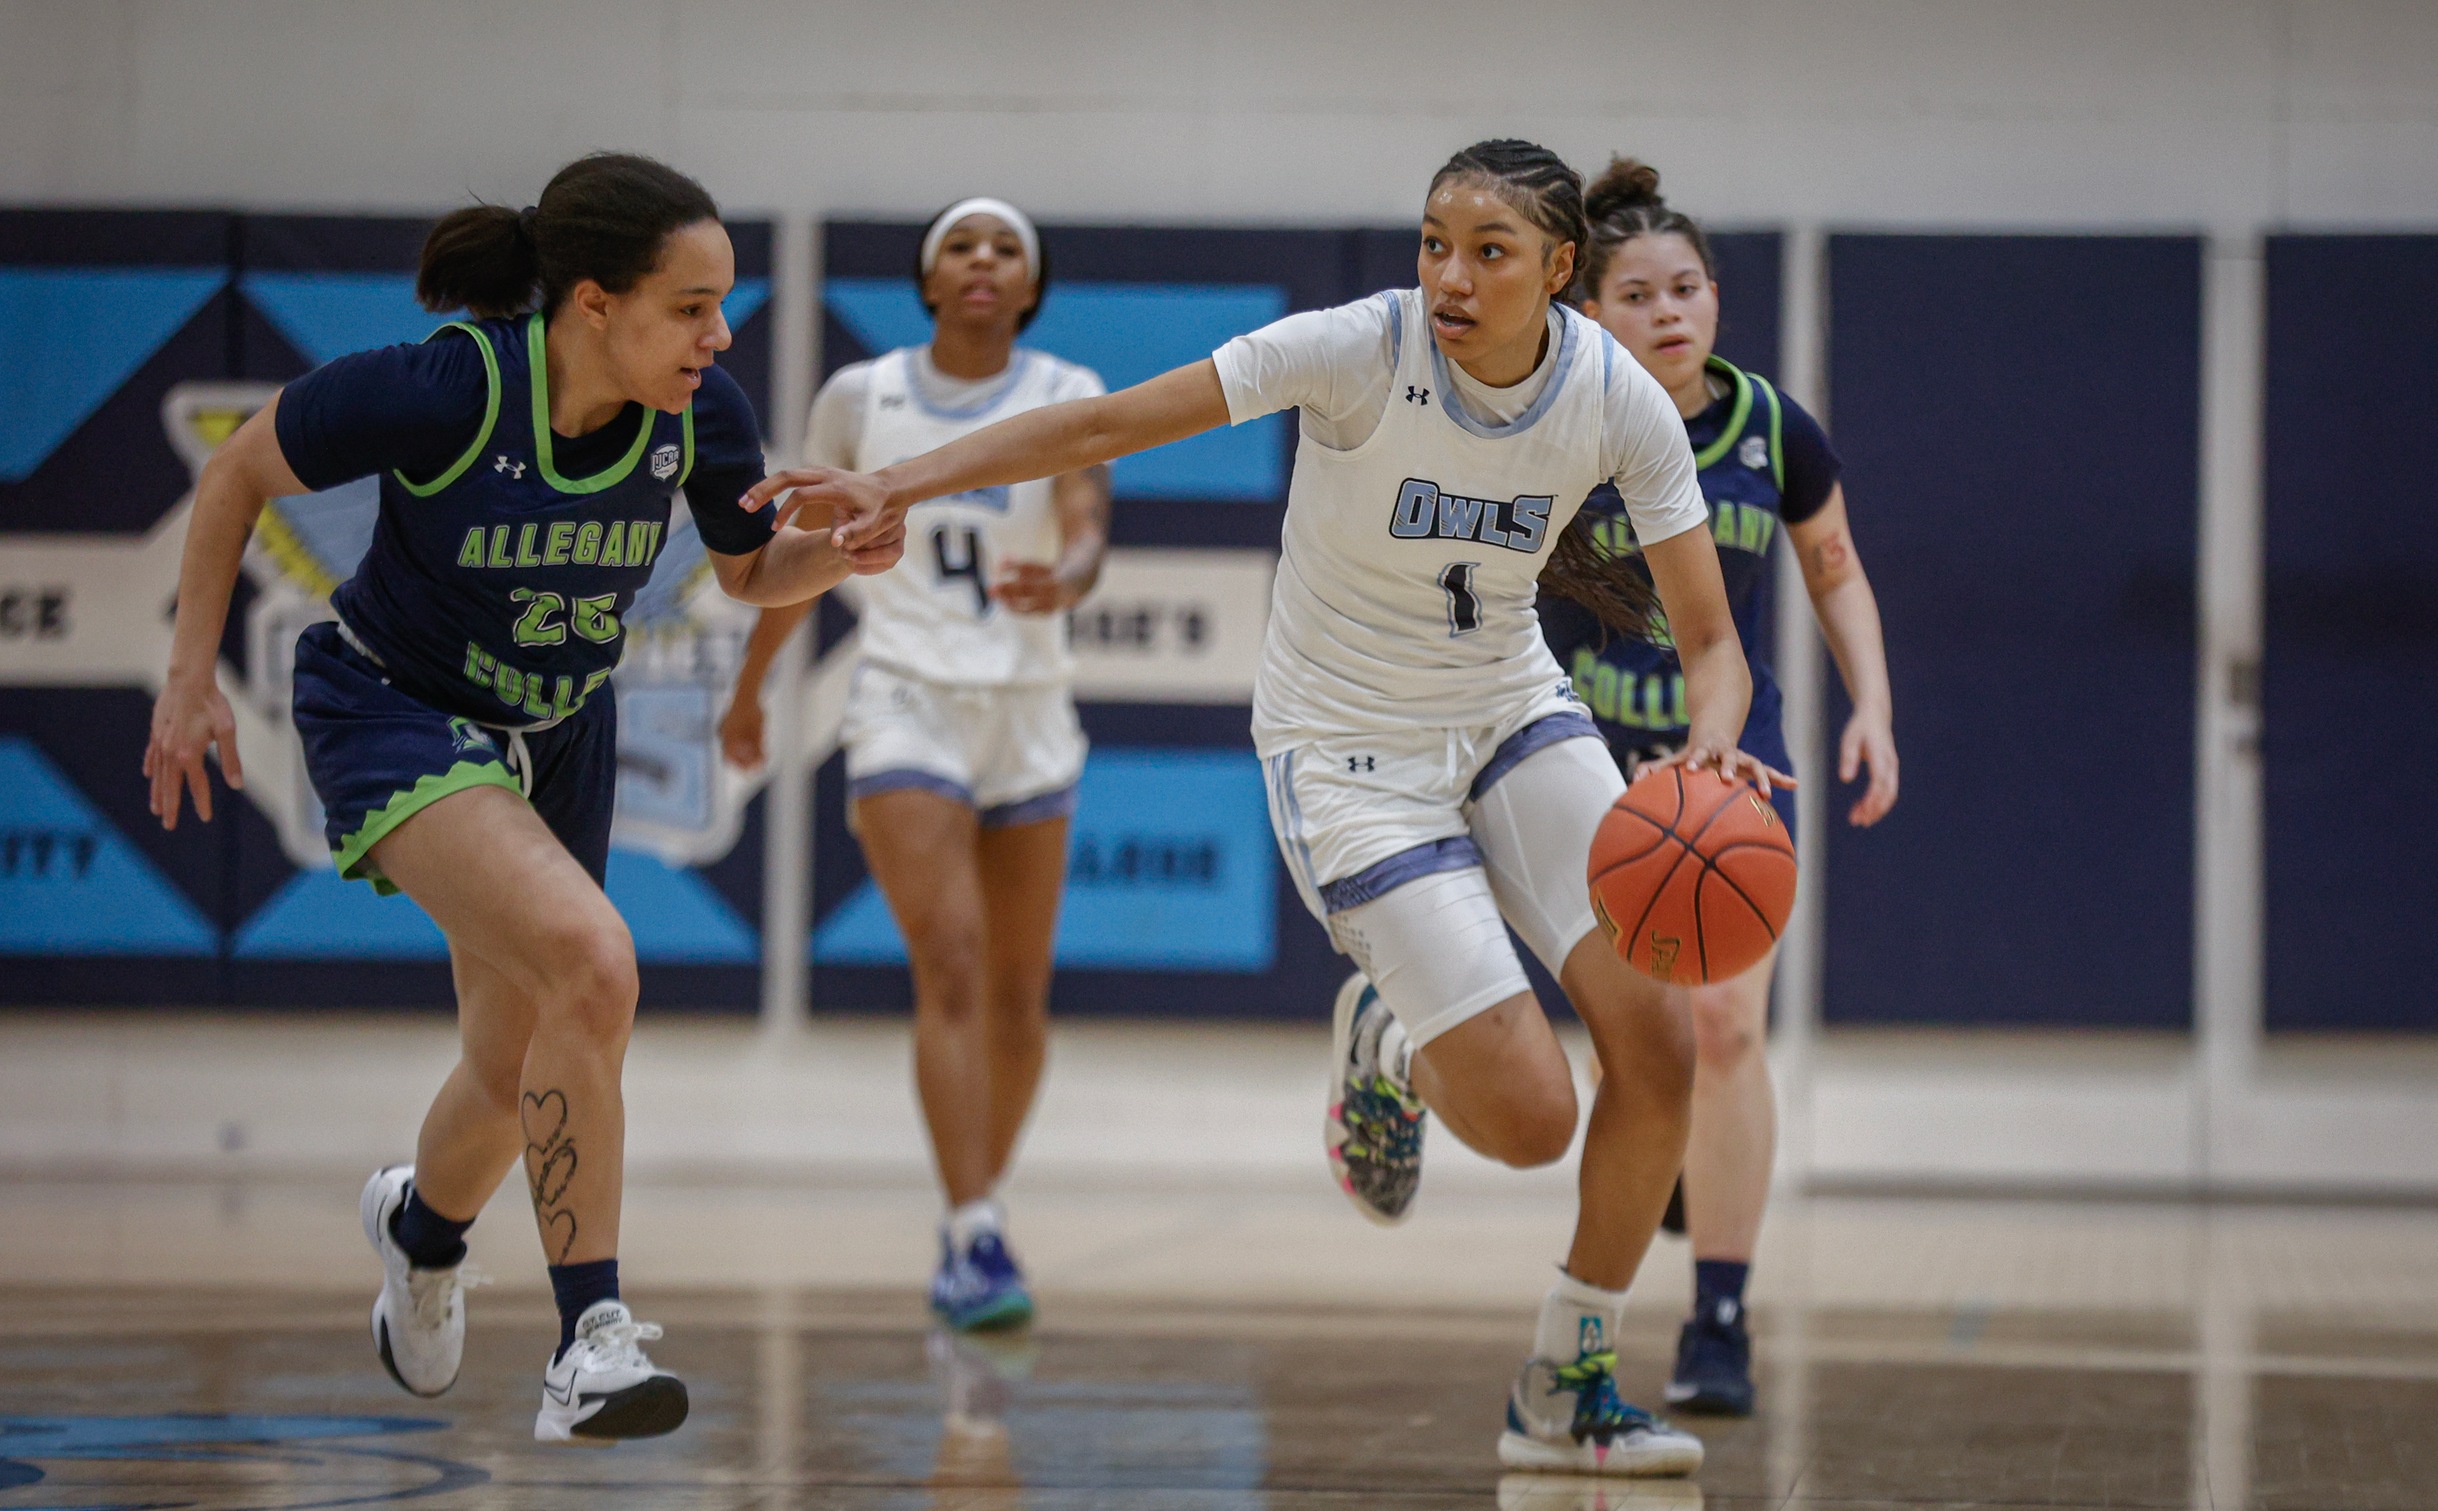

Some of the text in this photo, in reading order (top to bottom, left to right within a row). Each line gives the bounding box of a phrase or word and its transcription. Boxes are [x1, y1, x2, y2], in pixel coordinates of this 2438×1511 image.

[652, 450, 679, 471] NJCAA
[457, 520, 663, 568] ALLEGANY
[1389, 477, 1554, 554] OWLS
[930, 525, 993, 618] 4
[1437, 561, 1483, 638] 1
